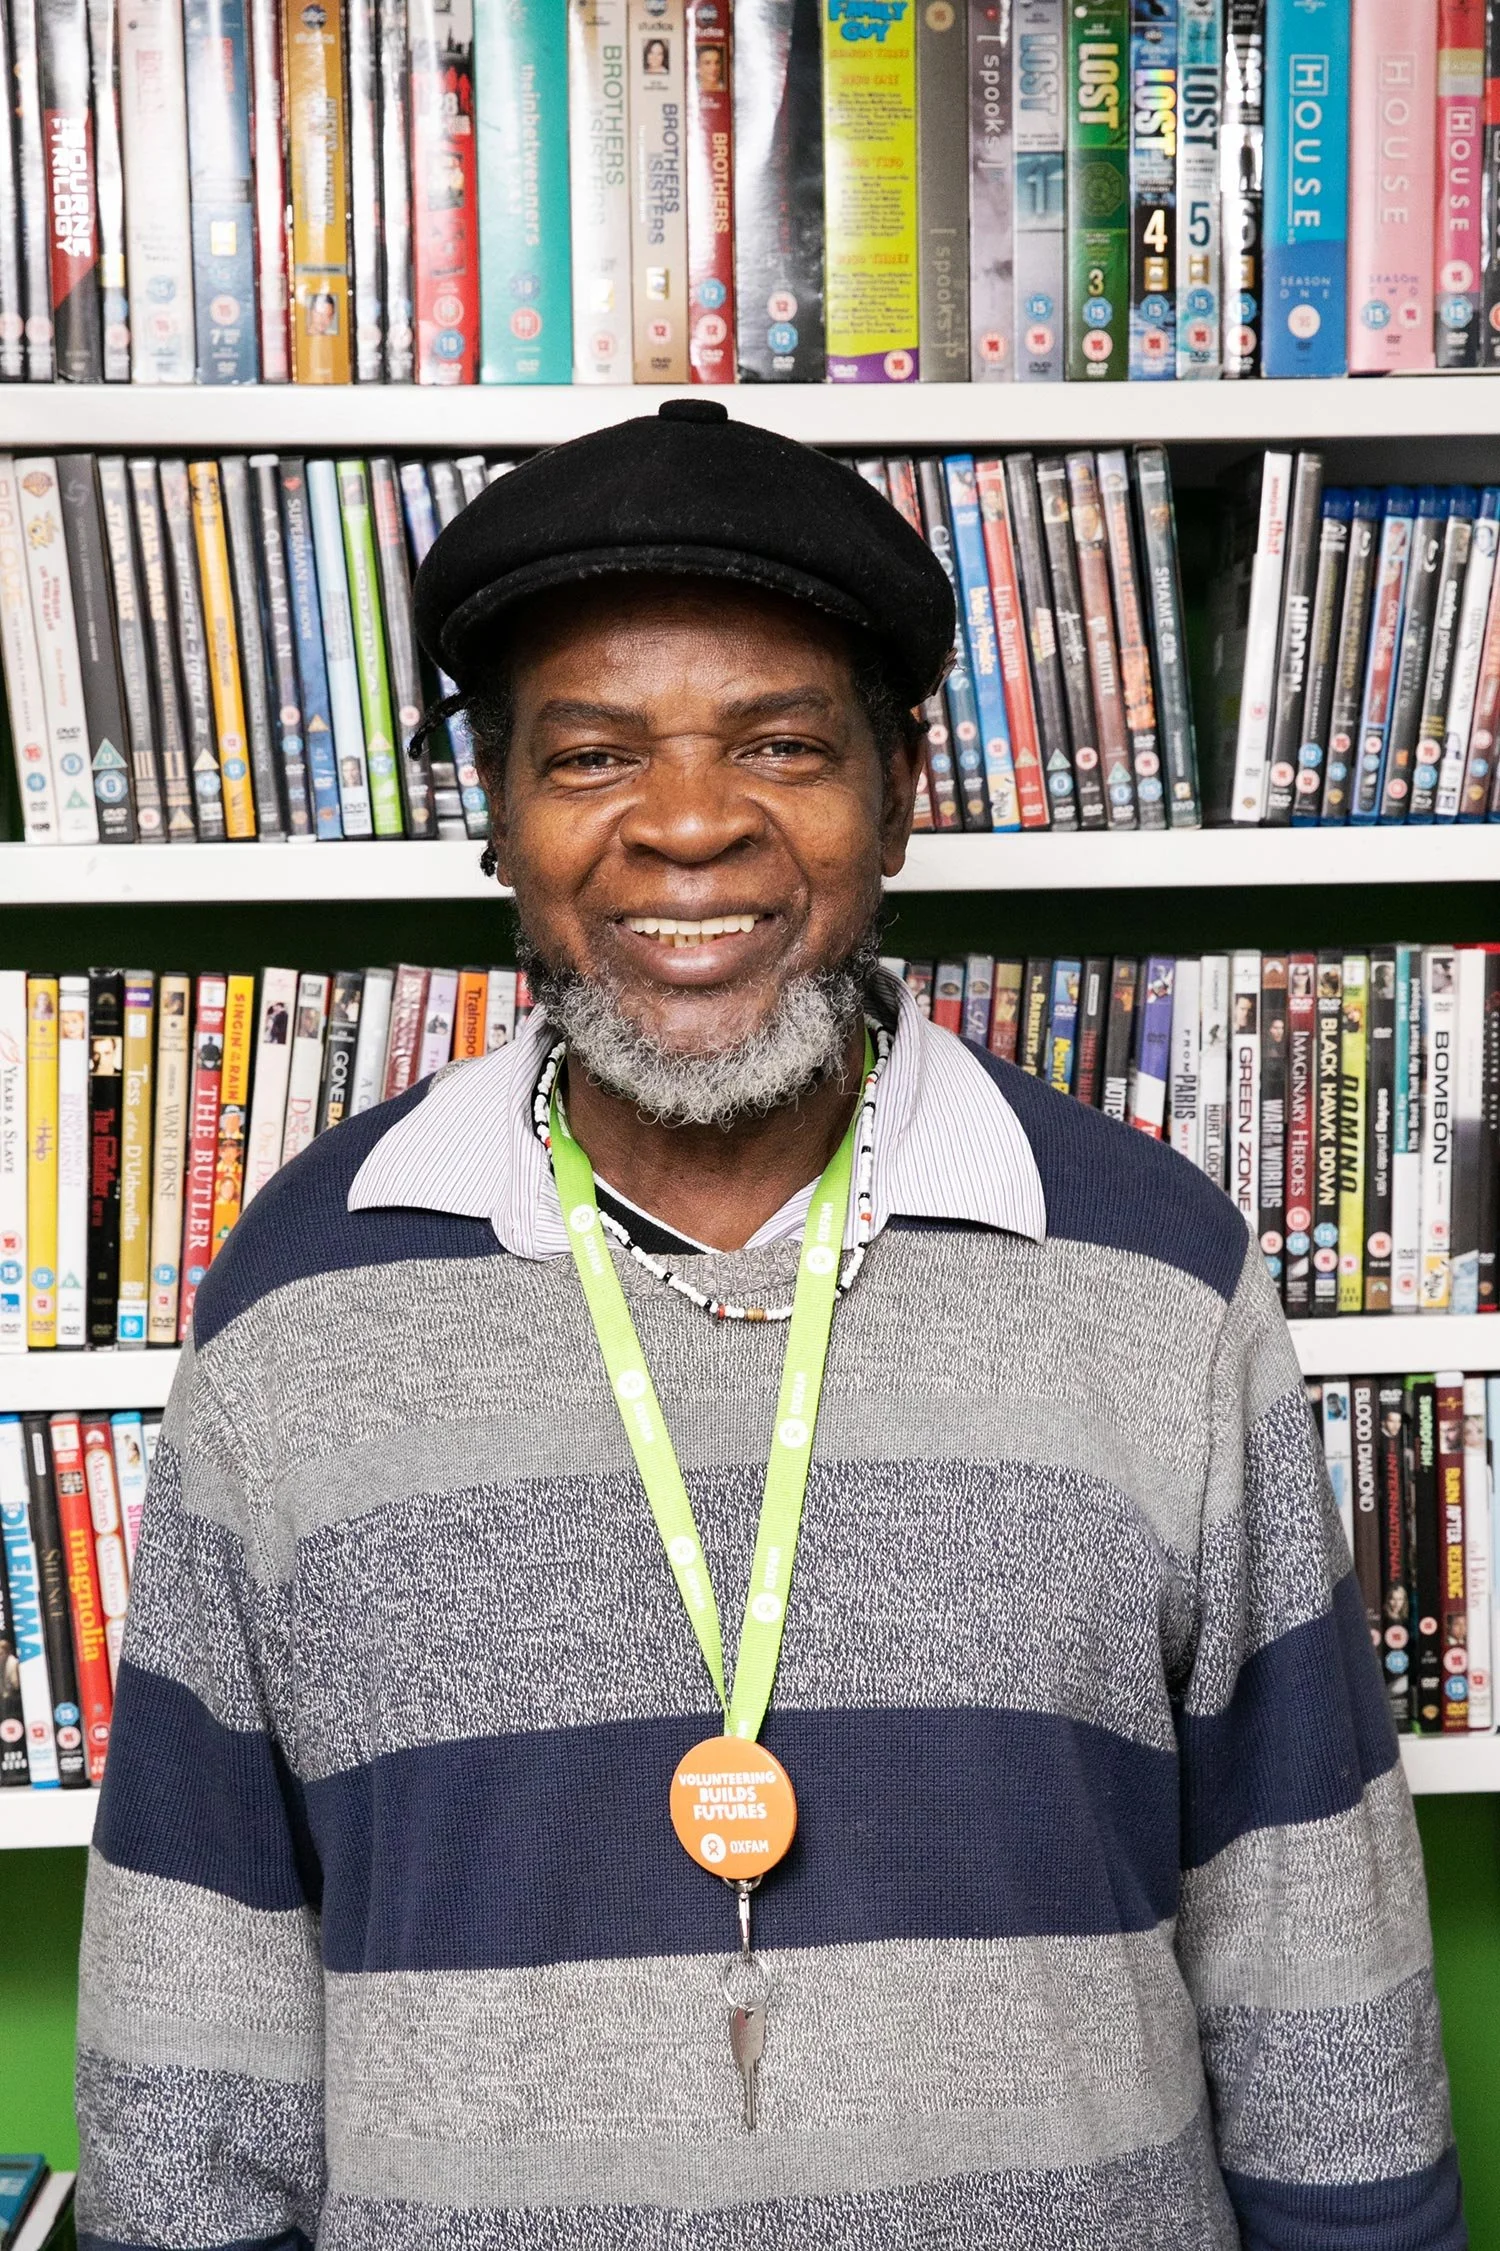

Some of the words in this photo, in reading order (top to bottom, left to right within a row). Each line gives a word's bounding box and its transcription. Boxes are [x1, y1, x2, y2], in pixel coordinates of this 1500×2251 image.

[841, 21, 891, 42] GUY
[1019, 32, 1060, 118] LOST
[1078, 42, 1120, 130] LOST
[603, 45, 625, 186] BROTHERS
[980, 55, 1002, 149] spooks
[1134, 68, 1177, 157] LOST
[1183, 67, 1219, 151] LOST
[661, 102, 680, 213] BROTHERS
[1293, 60, 1324, 229] HOUSE
[1384, 60, 1410, 225] HOUSE
[711, 132, 729, 233] BROTHERS
[1448, 108, 1471, 233] HOUSE
[1143, 208, 1169, 253] 4
[1188, 200, 1211, 247] 5
[775, 300, 789, 313] 12
[935, 246, 958, 333] spooks
[1088, 268, 1104, 297] 3
[1280, 276, 1331, 288] SEASON
[653, 324, 666, 337] 12
[705, 324, 719, 336] 12
[105, 499, 127, 558] STAR
[138, 498, 160, 558] STAR
[286, 498, 312, 581] SUPERMAN
[1266, 519, 1286, 556] that
[262, 507, 293, 659] AQUAMAN
[1154, 566, 1176, 629] SHAME
[1438, 580, 1458, 630] saving
[1287, 594, 1311, 694] HIDDEN
[229, 992, 247, 1050] SINGIN'
[458, 985, 484, 1058] Trainspo
[1022, 992, 1046, 1055] BARKLEYS
[1408, 977, 1422, 1023] Skipped
[1052, 1036, 1073, 1080] MONTY
[1183, 1029, 1192, 1073] FROM
[1319, 1017, 1340, 1077] BLACK
[1408, 1023, 1422, 1056] Heart
[1408, 1056, 1422, 1075] My
[3, 1066, 20, 1112] YEARS
[127, 1063, 151, 1105] Tess
[226, 1065, 244, 1101] RAIN
[328, 1049, 351, 1102] GONE
[1103, 1076, 1129, 1122] NOTES
[1173, 1073, 1198, 1121] PARIS
[1238, 1046, 1254, 1134] GREEN
[1290, 1030, 1310, 1125] IMAGINARY
[1408, 1076, 1422, 1101] That
[160, 1103, 181, 1139] WAR
[195, 1084, 219, 1139] THE
[325, 1101, 346, 1129] BA
[1204, 1103, 1220, 1140] HURT
[1261, 1099, 1284, 1134] WAR
[1319, 1082, 1338, 1141] HAWK
[1337, 1074, 1361, 1195] DOMINO
[1375, 1087, 1390, 1132] saving
[1408, 1102, 1422, 1129] Beat
[3, 1129, 19, 1176] SLAVE
[1179, 1122, 1191, 1157] WIT
[1204, 1142, 1220, 1180] LOCK
[1288, 1128, 1309, 1197] HEROES
[1375, 1132, 1390, 1170] private
[1408, 1129, 1422, 1151] The
[124, 1143, 145, 1242] D'Urbervilles
[158, 1146, 180, 1201] HORSE
[187, 1148, 217, 1250] BUTLER
[1236, 1140, 1253, 1212] ZONE
[1260, 1146, 1284, 1209] WORLDS
[1318, 1145, 1337, 1207] DOWN
[1373, 1170, 1388, 1197] ryan
[815, 1202, 834, 1242] OXFAM
[1354, 1386, 1374, 1439] BLOOD
[1418, 1394, 1434, 1465] SWORDFISH
[1357, 1442, 1376, 1513] DIAMOND
[1444, 1466, 1462, 1503] BURN
[1385, 1453, 1403, 1581] INTERNATIONAL
[1445, 1503, 1463, 1543] AFTER
[0, 1501, 44, 1665] DILEMMA
[41, 1548, 65, 1619] SILENCE
[68, 1528, 107, 1663] magnolia
[1447, 1544, 1464, 1600] READING
[678, 1770, 777, 1787] VOLUNTEERING
[699, 1786, 758, 1804] BUILDS
[692, 1802, 768, 1821] FUTURES
[729, 1839, 770, 1854] OXFAM
